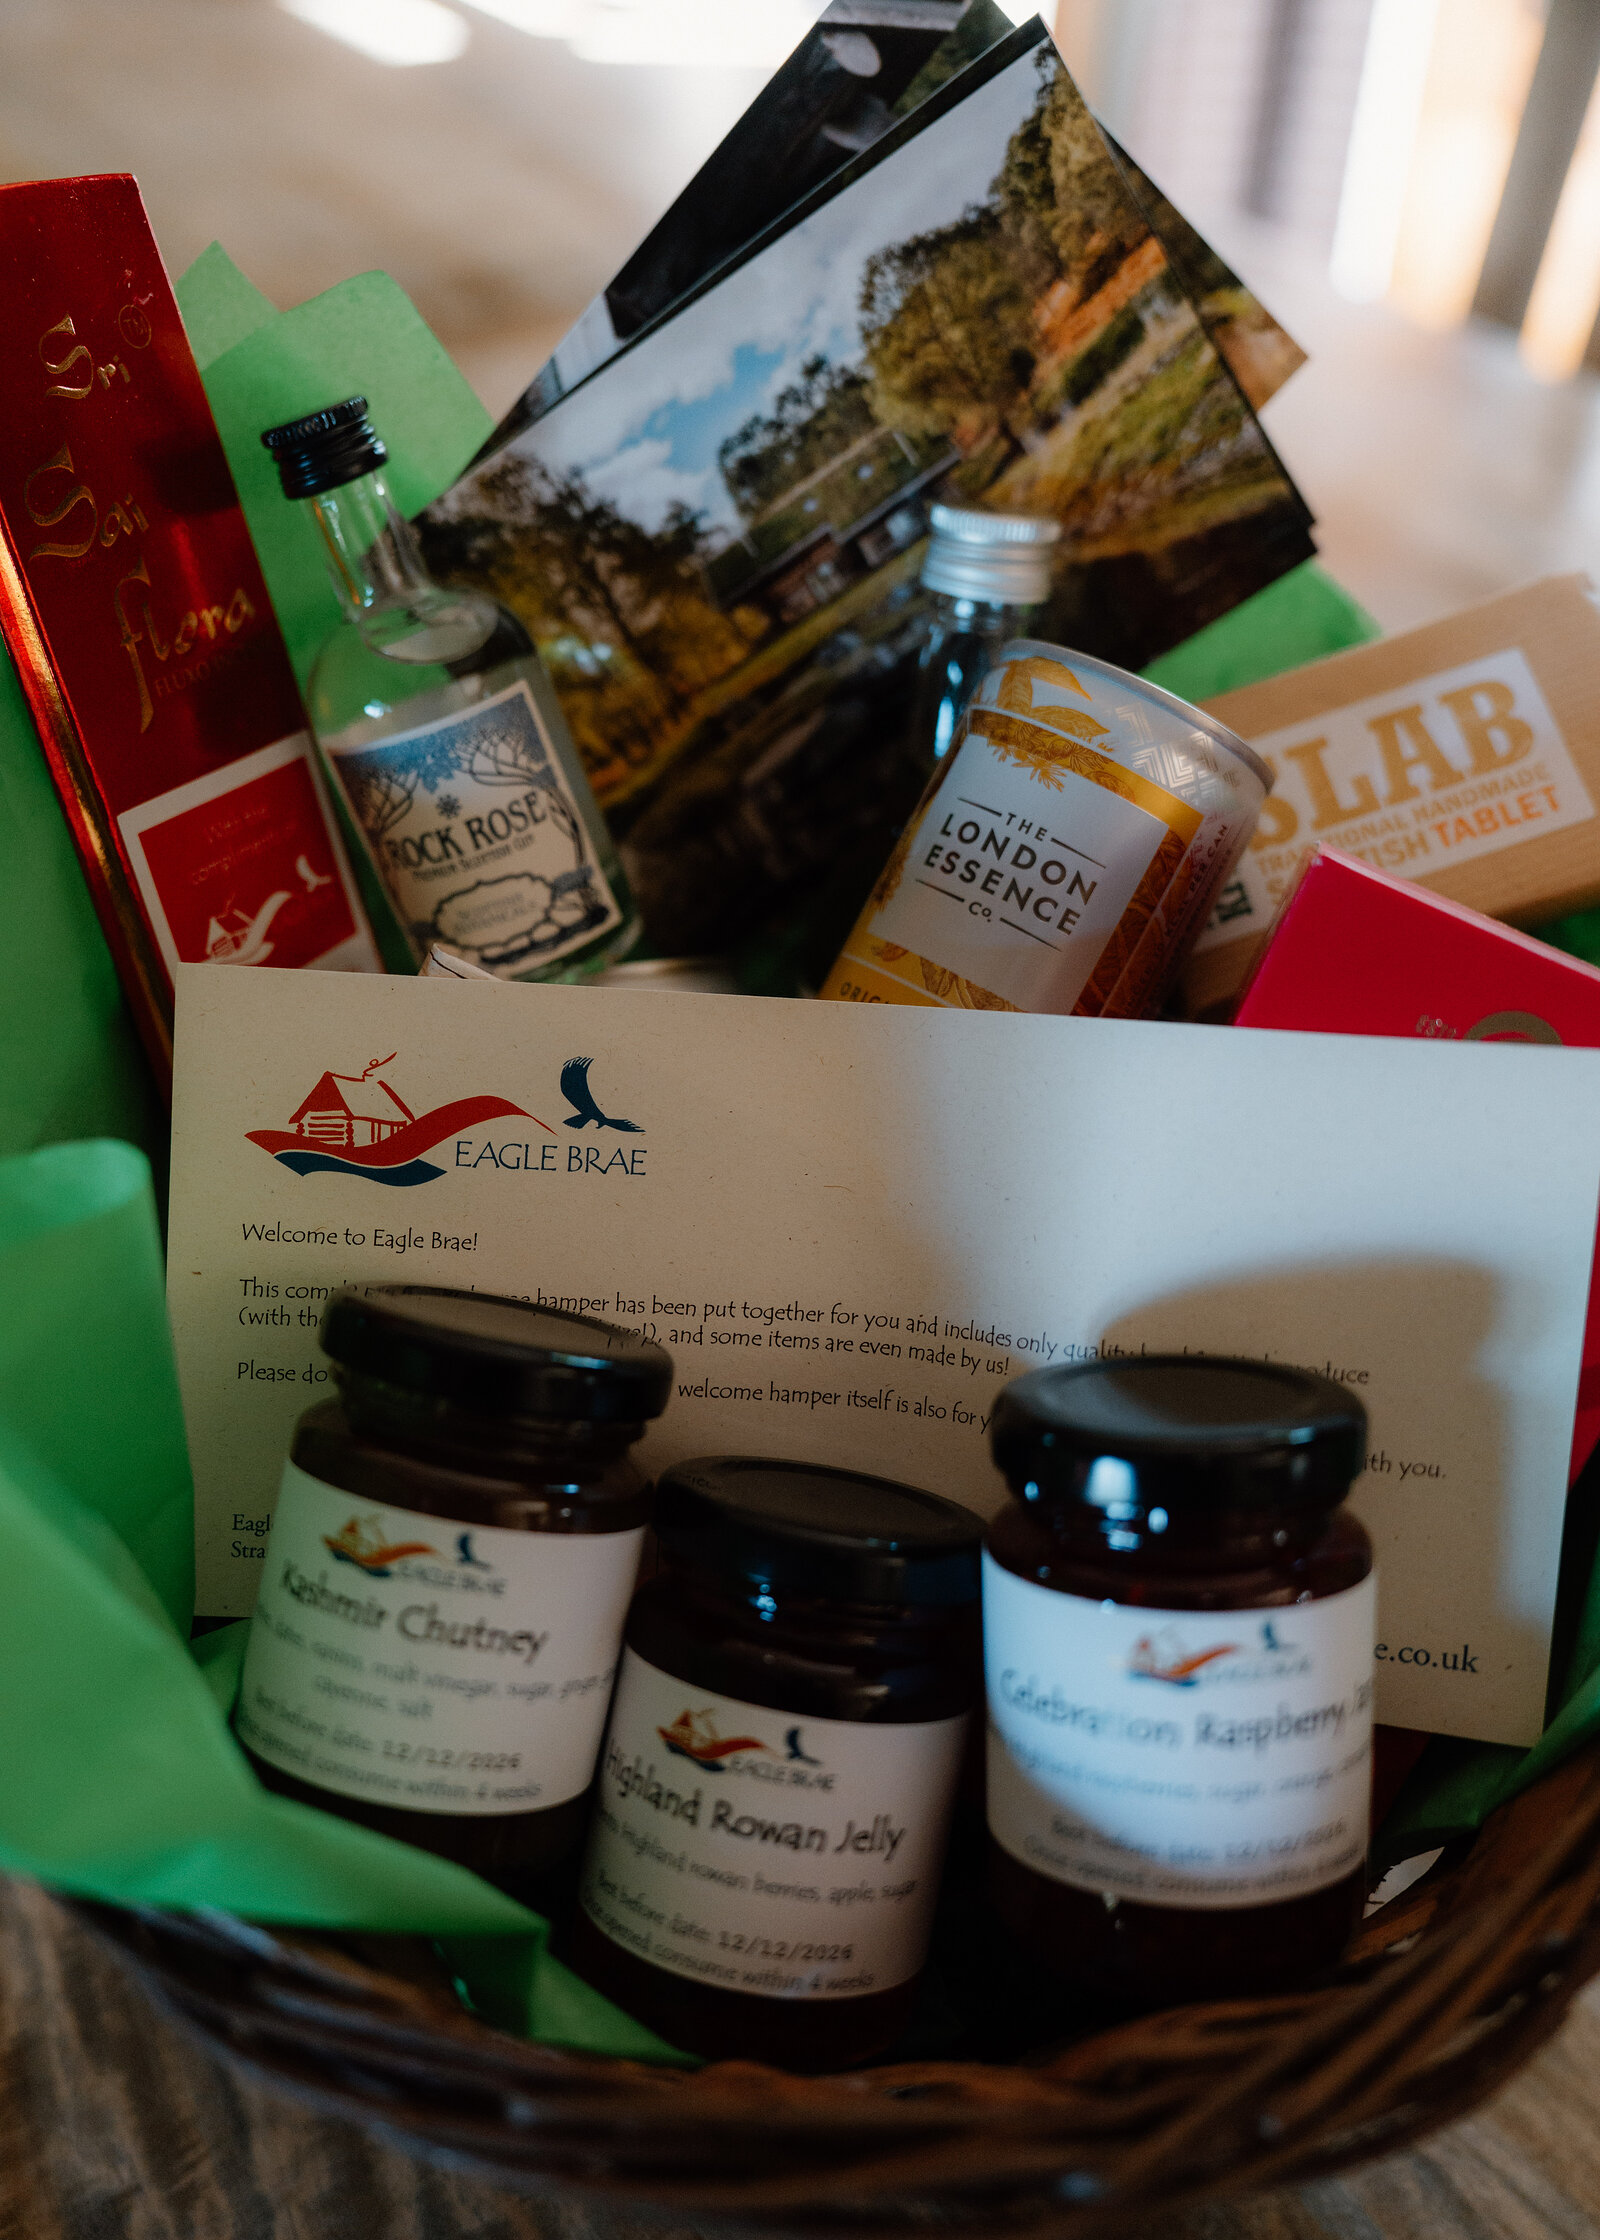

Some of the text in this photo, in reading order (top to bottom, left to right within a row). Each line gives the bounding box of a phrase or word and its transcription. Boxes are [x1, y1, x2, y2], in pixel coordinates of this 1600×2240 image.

[39, 313, 132, 399] Sri
[23, 442, 150, 562] Sai
[114, 556, 257, 734] flora
[465, 791, 547, 850] ROSE
[1005, 812, 1048, 842] THE
[1431, 785, 1562, 848] TABLET
[939, 812, 1098, 906] LONDON
[1206, 824, 1229, 860] CAN
[924, 845, 1082, 936] ESSENCE
[455, 1140, 648, 1177] EAGLE BRAE
[242, 1221, 478, 1253] Welcome to Eagle Brae!
[239, 1276, 280, 1298] This
[238, 1304, 291, 1328] (with
[537, 1287, 610, 1316] hamper
[616, 1291, 645, 1315] has
[652, 1294, 697, 1318] been
[703, 1301, 736, 1322] put
[742, 1300, 825, 1326] together
[830, 1302, 859, 1325] for
[864, 1313, 900, 1333] you
[906, 1315, 938, 1337] and
[944, 1319, 1012, 1348] includes
[1016, 1331, 1059, 1361] only
[1063, 1339, 1134, 1361] qualit
[237, 1359, 328, 1384] Please do
[669, 1325, 703, 1346] and
[710, 1329, 762, 1347] some
[768, 1331, 820, 1350] items
[824, 1336, 854, 1353] are
[859, 1340, 901, 1358] even
[908, 1346, 956, 1366] made
[961, 1347, 981, 1375] by
[986, 1357, 1010, 1376] us!
[678, 1378, 763, 1401] welcome
[770, 1381, 841, 1410] hamper
[847, 1388, 895, 1411] itself
[896, 1395, 909, 1413] is
[913, 1395, 947, 1419] also
[952, 1401, 976, 1425] for
[1363, 1450, 1447, 1481] ith you.
[231, 1513, 273, 1537] Eagl
[280, 1560, 388, 1628] Kashmir
[395, 1602, 549, 1665] Chutney
[711, 1799, 829, 1853] Rowan
[834, 1812, 907, 1863] Jelly
[718, 1930, 856, 1961] 12/12/2026
